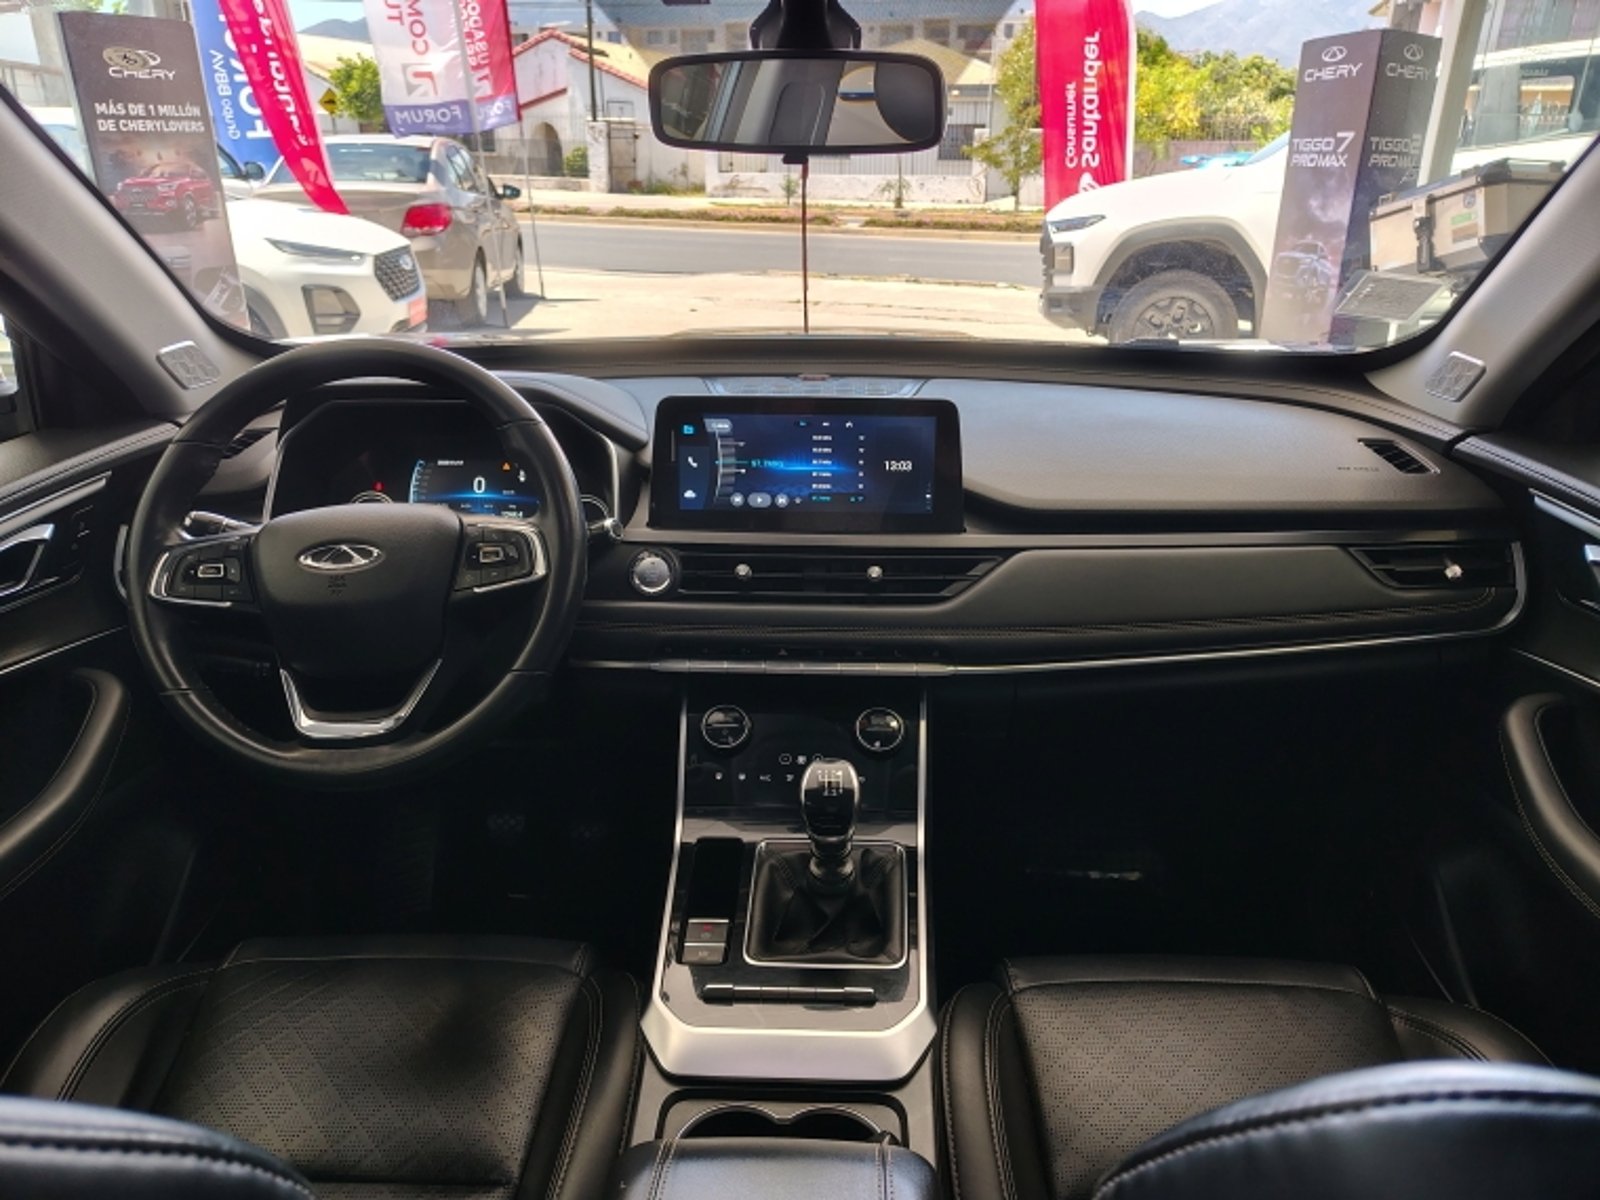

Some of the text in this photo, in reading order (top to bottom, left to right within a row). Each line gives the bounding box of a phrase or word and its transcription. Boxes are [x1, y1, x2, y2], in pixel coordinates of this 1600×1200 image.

[108, 67, 176, 81] CHERY
[1304, 62, 1363, 83] CHERY
[1385, 62, 1432, 81] CHERY
[94, 99, 201, 117] MÁS DE 1 MILLÓN
[96, 119, 205, 132] DE CHERYLOVERS
[473, 476, 486, 494] 0
